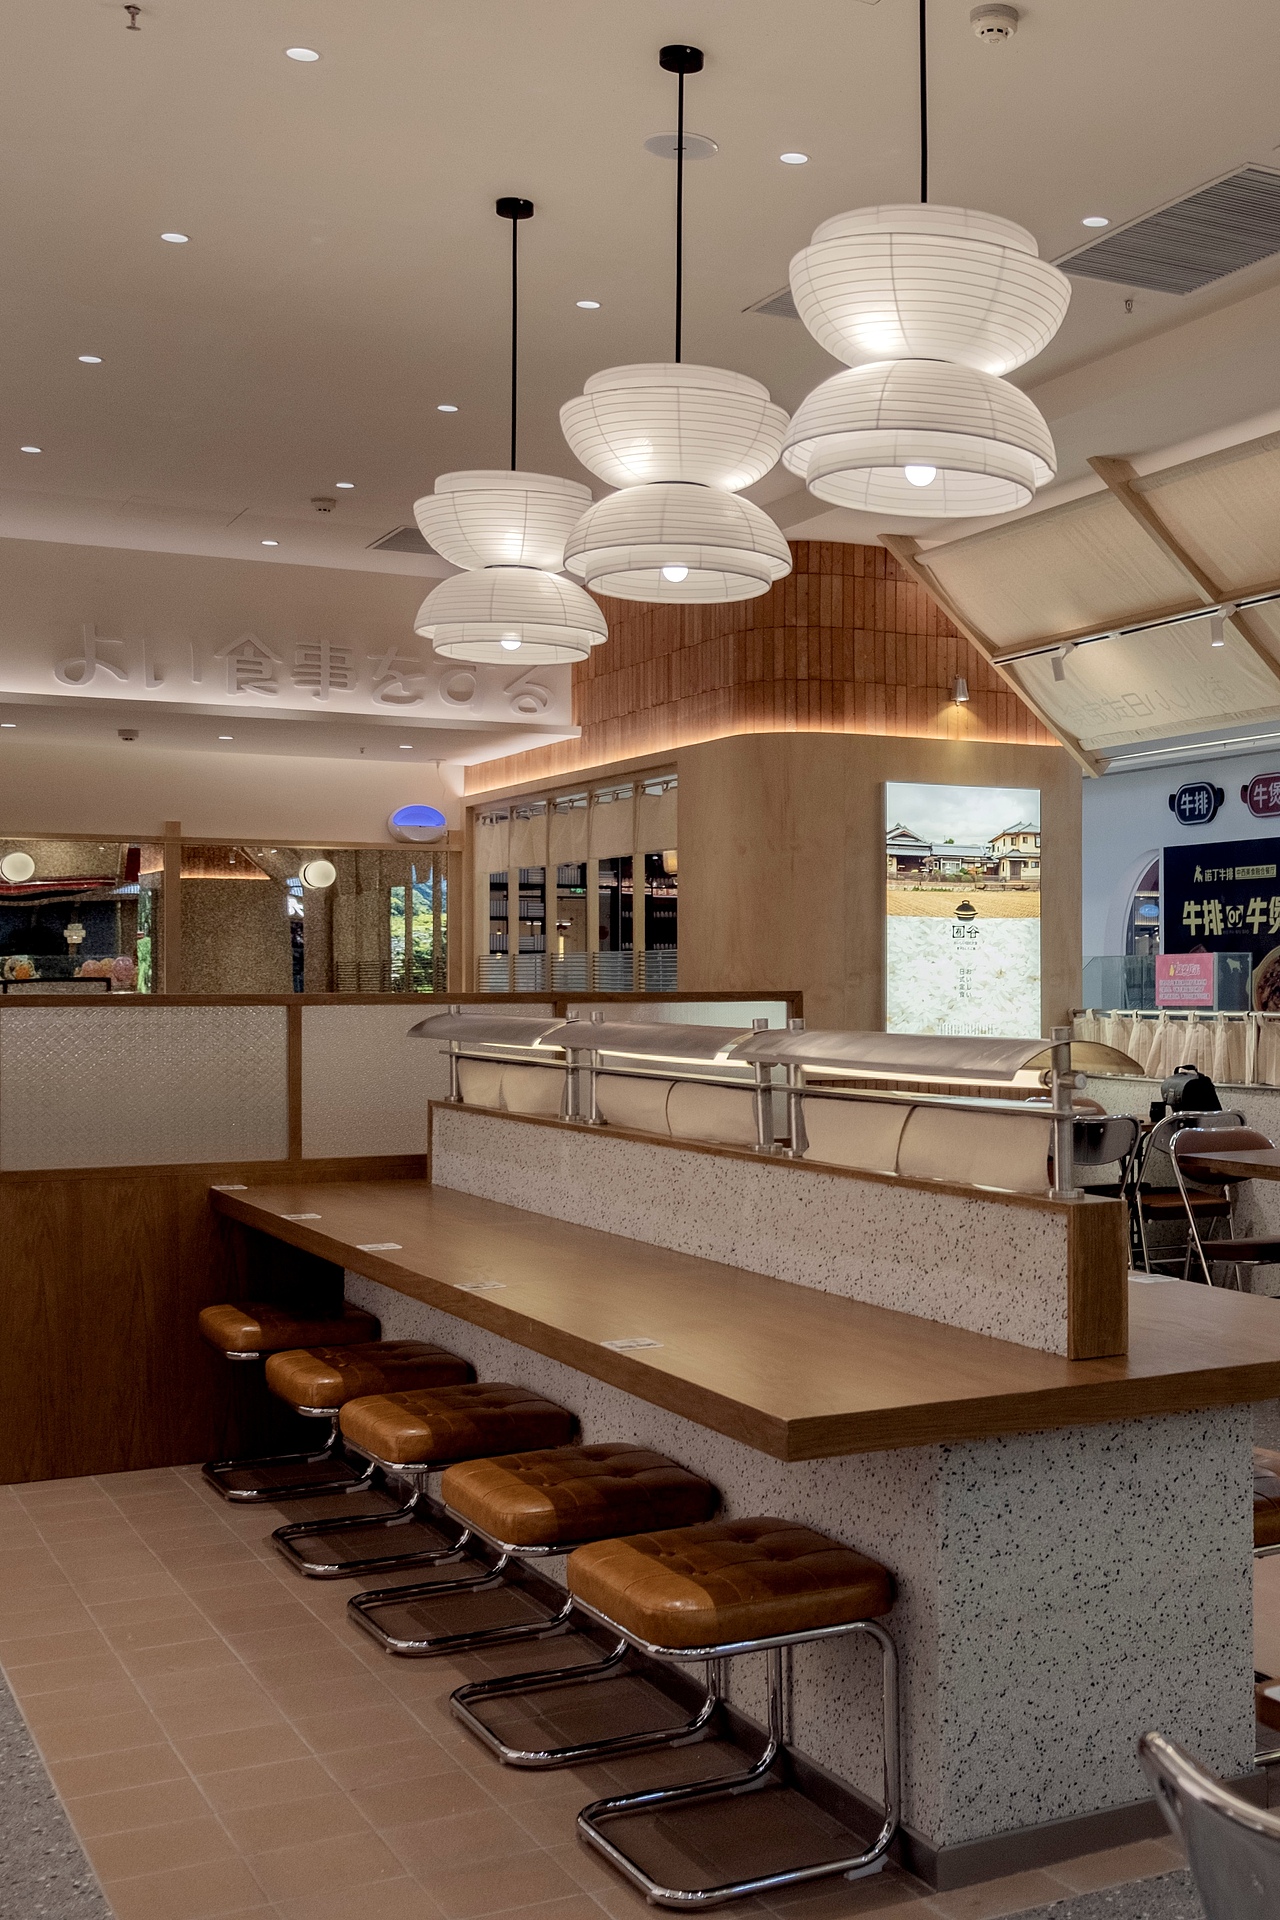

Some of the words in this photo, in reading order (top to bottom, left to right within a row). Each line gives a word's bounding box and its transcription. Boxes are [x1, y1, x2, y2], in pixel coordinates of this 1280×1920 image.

[53, 623, 556, 717] よい食事をする
[1180, 791, 1208, 817] 牛排
[1183, 899, 1224, 936] 牛排
[1229, 910, 1241, 924] or
